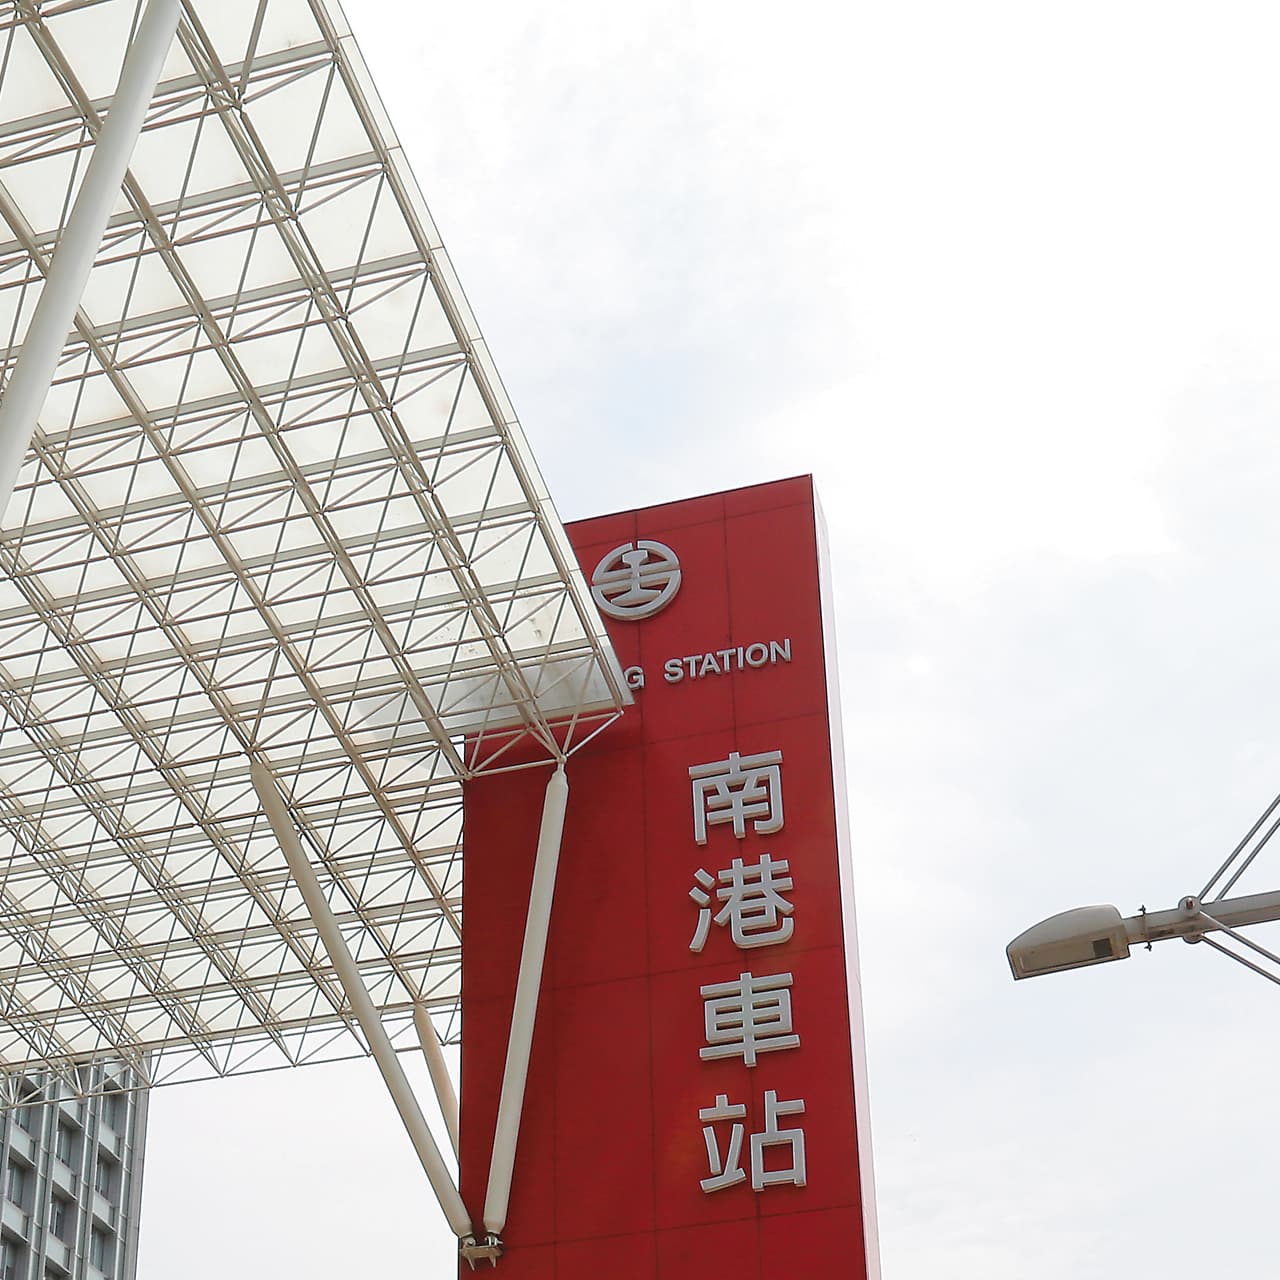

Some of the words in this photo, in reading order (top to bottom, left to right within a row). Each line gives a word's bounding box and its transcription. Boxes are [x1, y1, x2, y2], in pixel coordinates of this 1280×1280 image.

[663, 638, 792, 683] STATION
[688, 750, 808, 1193] 南港車站
